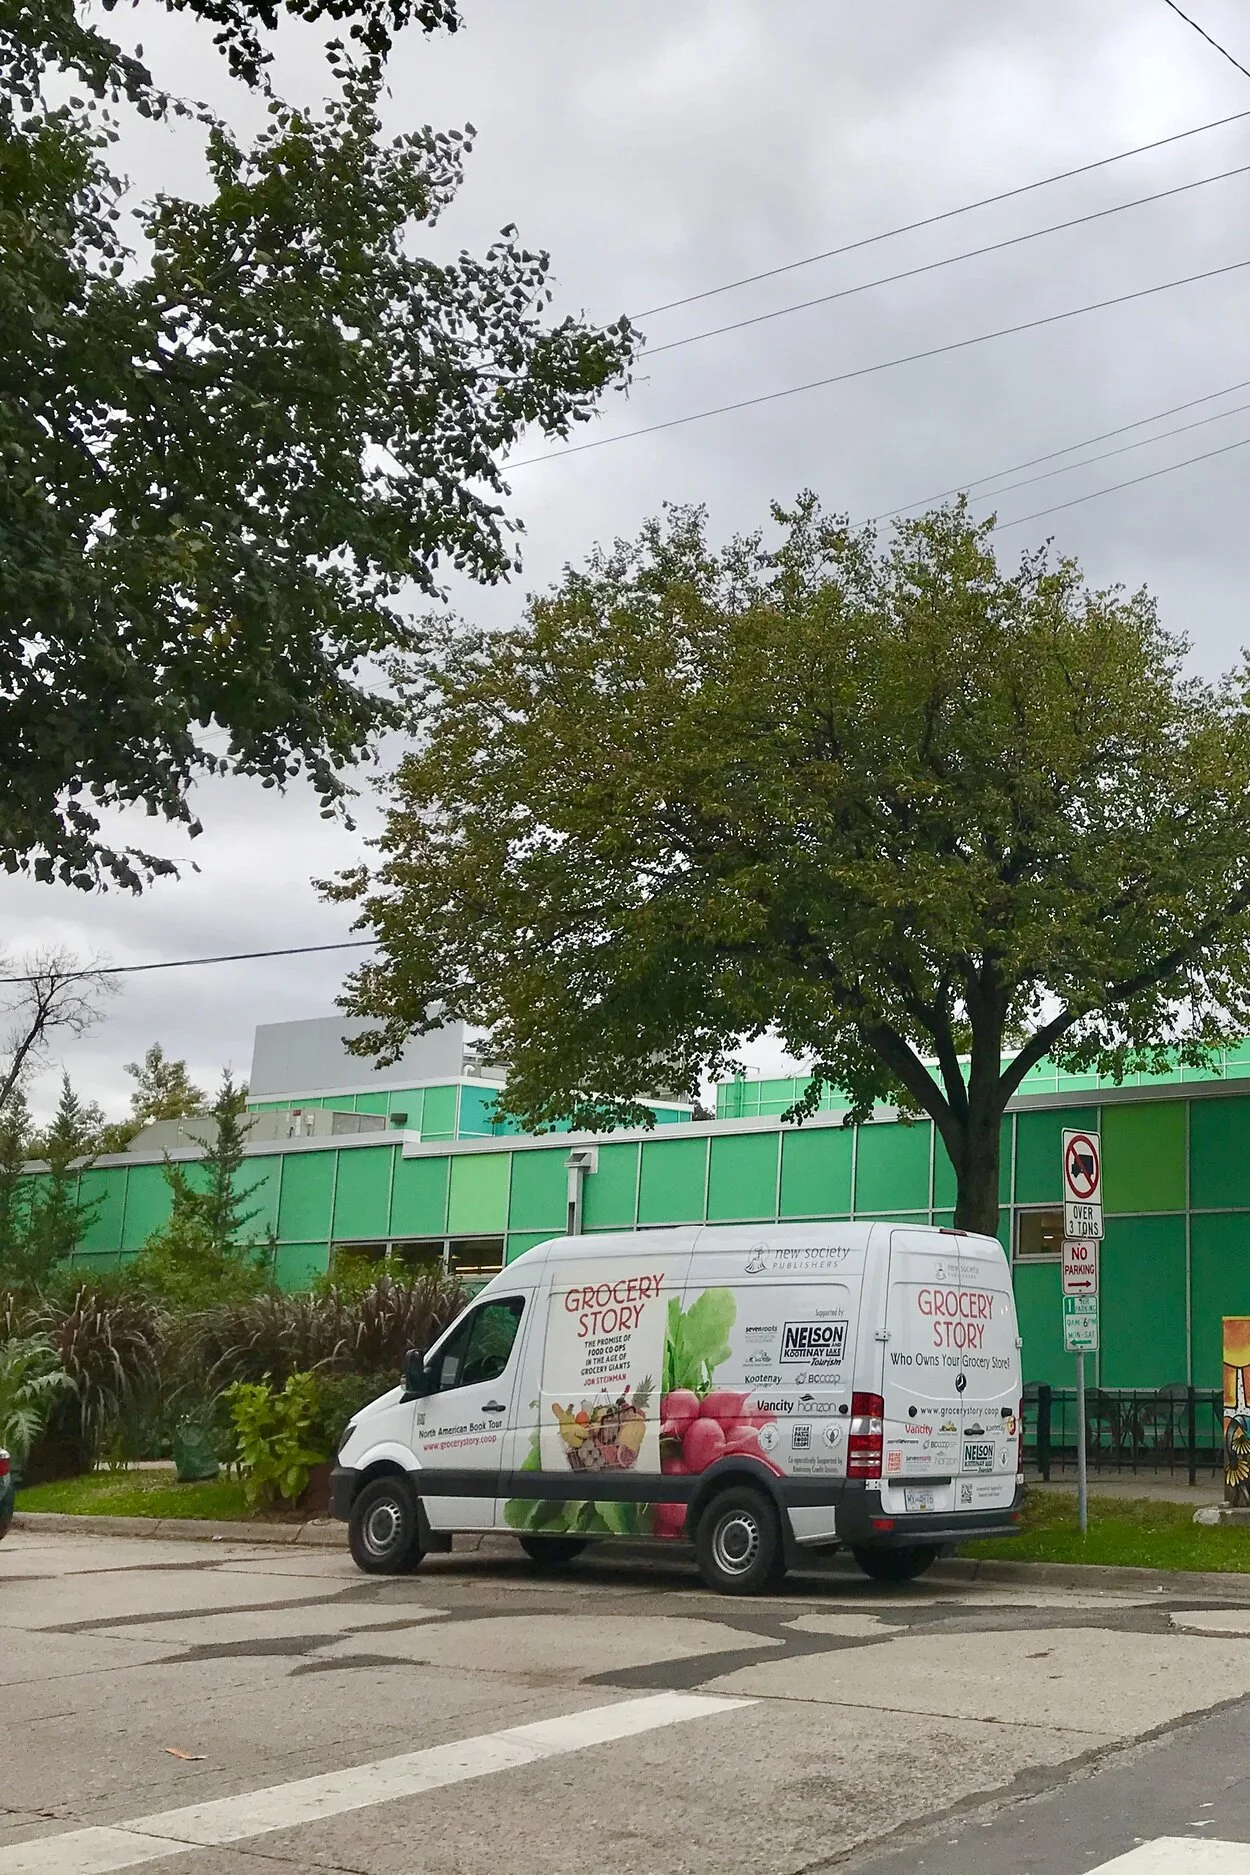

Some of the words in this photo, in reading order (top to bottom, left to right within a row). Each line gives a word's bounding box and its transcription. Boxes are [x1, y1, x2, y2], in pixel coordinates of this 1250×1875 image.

[1073, 1206, 1093, 1220] OVER
[1069, 1220, 1074, 1234] 3
[1077, 1221, 1099, 1235] TONS
[774, 1248, 801, 1259] new
[804, 1245, 850, 1261] society
[1072, 1247, 1087, 1260] NO
[772, 1261, 839, 1269] PUBLISHERS
[1065, 1264, 1095, 1275] PARKING
[564, 1273, 665, 1312] GROCERY
[917, 1289, 994, 1320] GROCERY
[1067, 1299, 1072, 1312] 1
[815, 1309, 837, 1317] Supported
[838, 1308, 845, 1316] by
[577, 1303, 645, 1337] STORY
[597, 1335, 622, 1346] PROMISE
[785, 1326, 844, 1348] NELSON
[933, 1320, 985, 1349] STORY
[588, 1347, 604, 1356] FOOD
[605, 1344, 626, 1353] CO-OPS
[593, 1356, 604, 1364] THE
[606, 1355, 618, 1363] AGE
[618, 1353, 627, 1361] OF
[811, 1358, 842, 1366] Tourism
[890, 1352, 912, 1366] Who
[915, 1352, 940, 1366] Owns
[942, 1354, 960, 1367] Your
[962, 1354, 990, 1369] Grocery
[991, 1356, 1010, 1369] Store?
[580, 1365, 607, 1376] GROCERY
[608, 1361, 631, 1371] GIANTS
[744, 1374, 782, 1385] Kootenay
[757, 1399, 794, 1414] Vancity
[920, 1406, 999, 1417] www.grocerystory.coop
[418, 1429, 436, 1439] North
[438, 1425, 468, 1436] American
[469, 1421, 486, 1431] Book
[488, 1419, 503, 1429] Tour
[905, 1424, 933, 1436] Vancity
[423, 1435, 497, 1450] www.grocerystory.coop
[964, 1444, 994, 1460] NELSON
